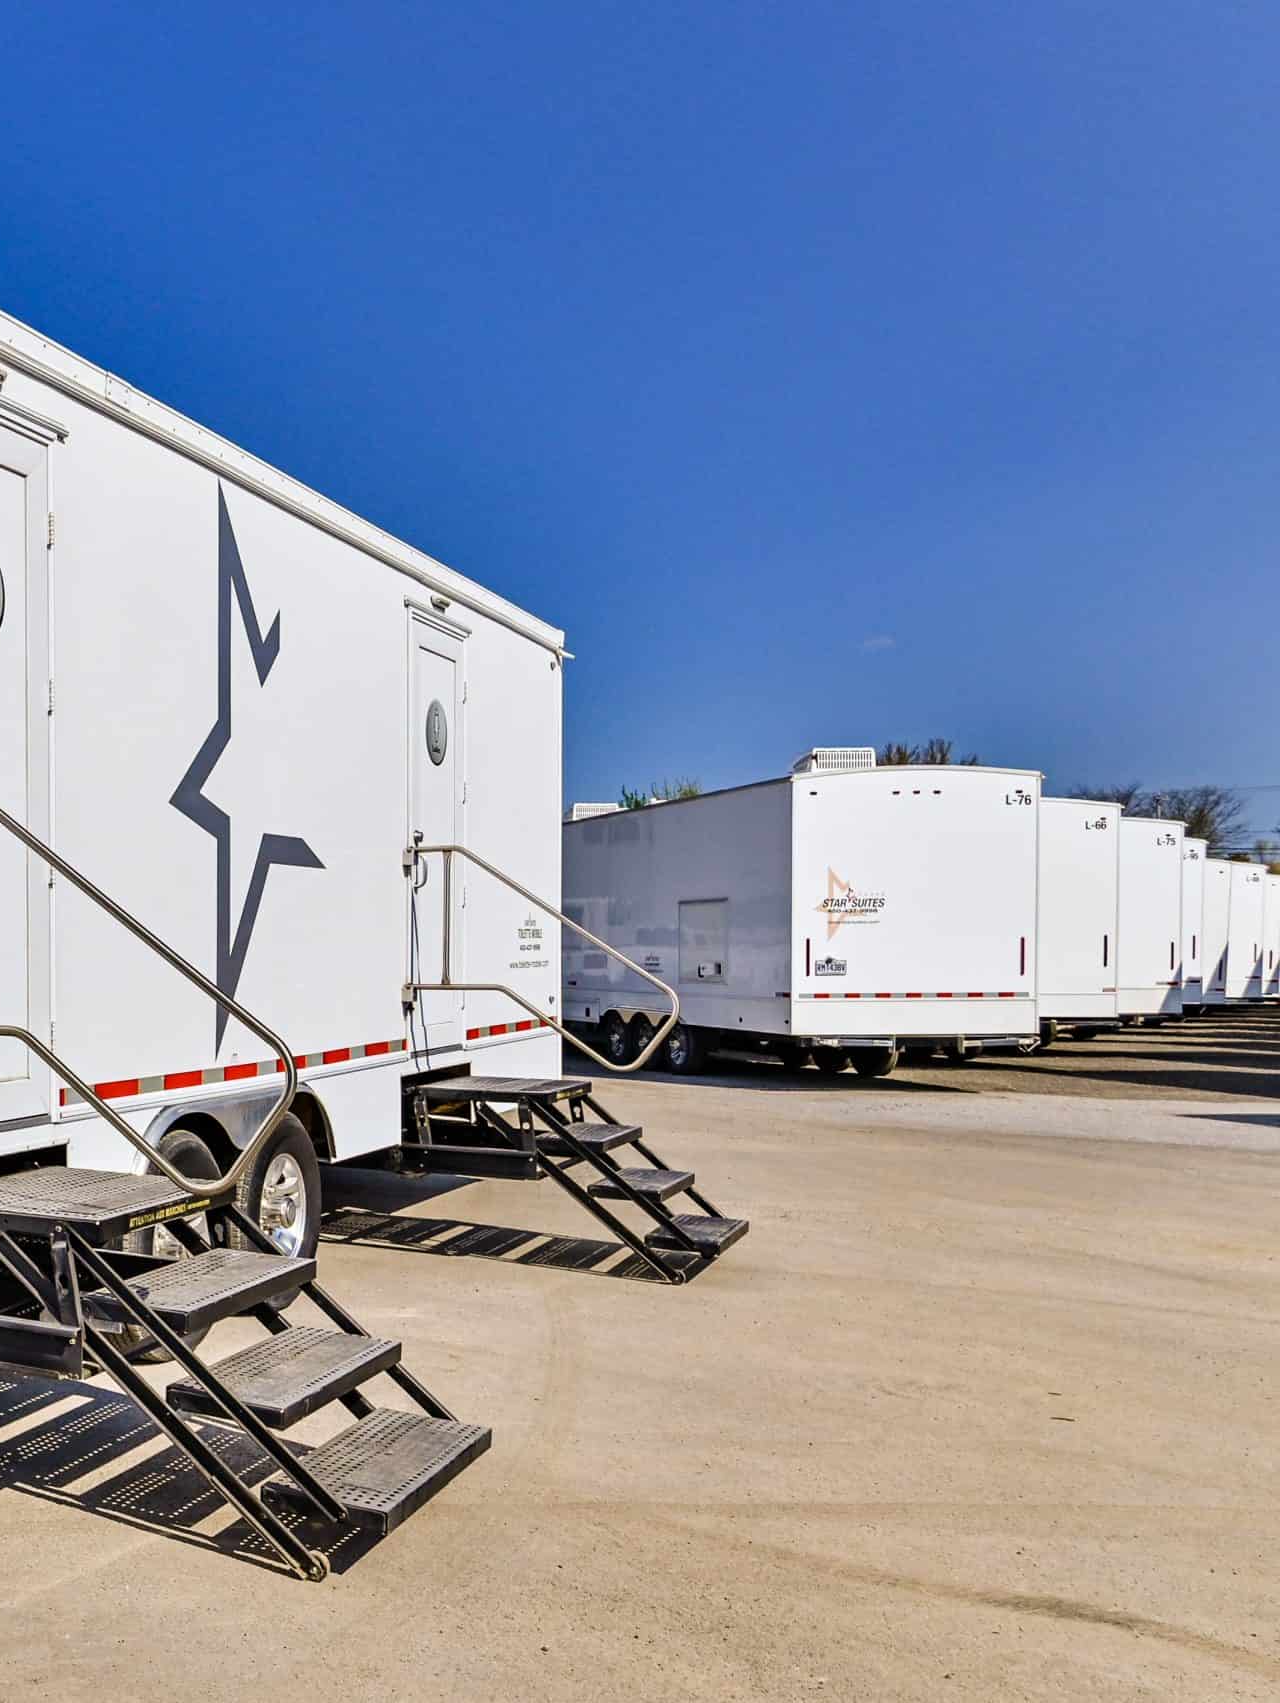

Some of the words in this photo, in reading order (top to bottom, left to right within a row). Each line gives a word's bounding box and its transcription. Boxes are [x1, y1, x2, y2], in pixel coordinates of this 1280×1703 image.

[1005, 793, 1032, 806] L-76
[822, 897, 848, 909] STAR
[851, 897, 887, 909] SUITES
